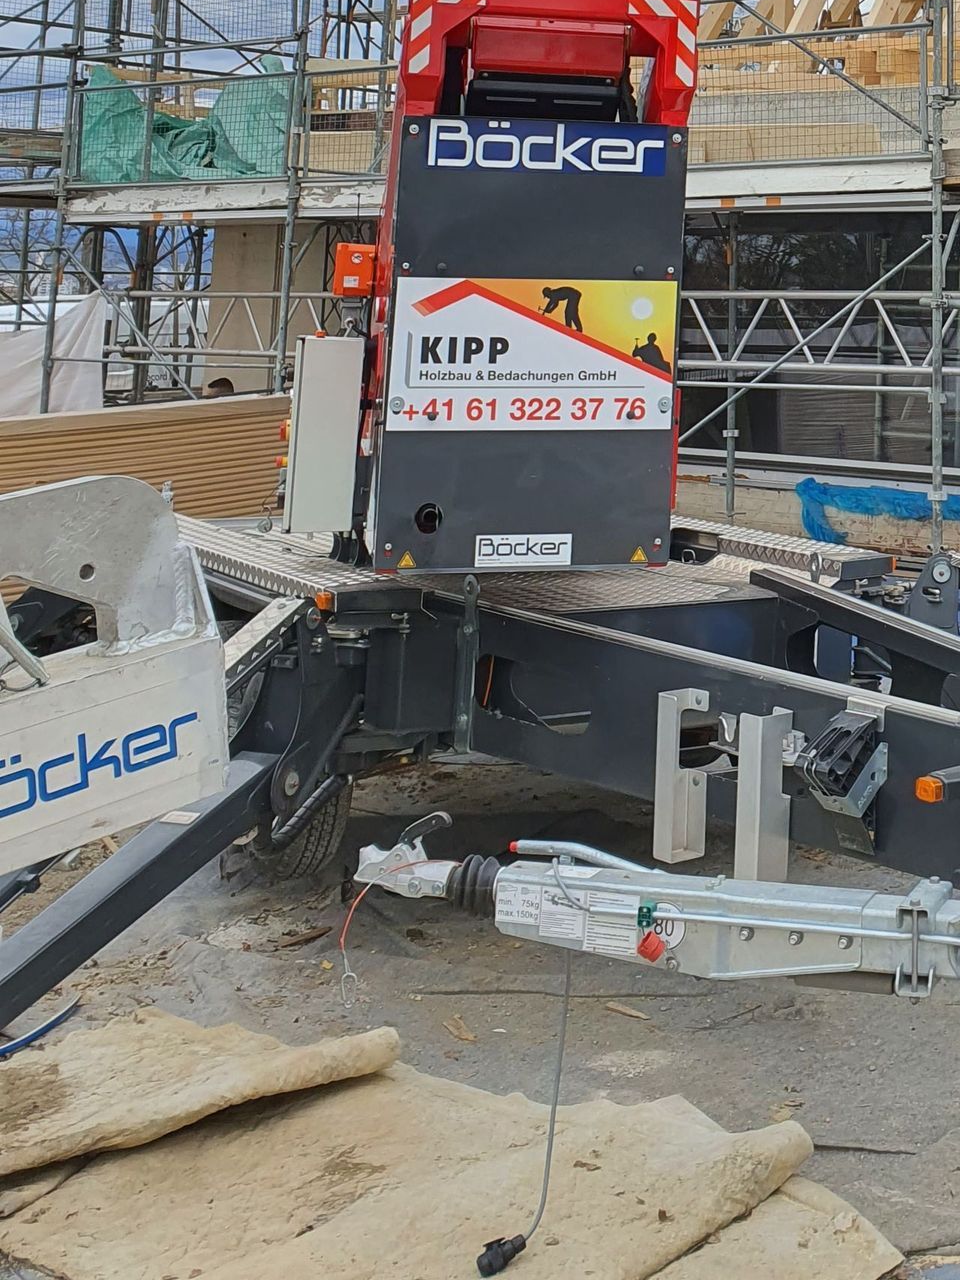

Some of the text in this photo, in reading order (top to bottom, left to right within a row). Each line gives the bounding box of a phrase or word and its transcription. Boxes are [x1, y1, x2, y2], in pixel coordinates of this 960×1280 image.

[428, 118, 665, 173] Böcker
[420, 336, 510, 365] KIPP
[418, 370, 618, 383] Holzbau & Bedachungen GmbH
[402, 397, 646, 421] +41 61 322 37 76
[478, 537, 568, 557] Böcker
[521, 899, 540, 911] 75kg
[516, 910, 539, 922] 150kg
[654, 919, 675, 937] 80
